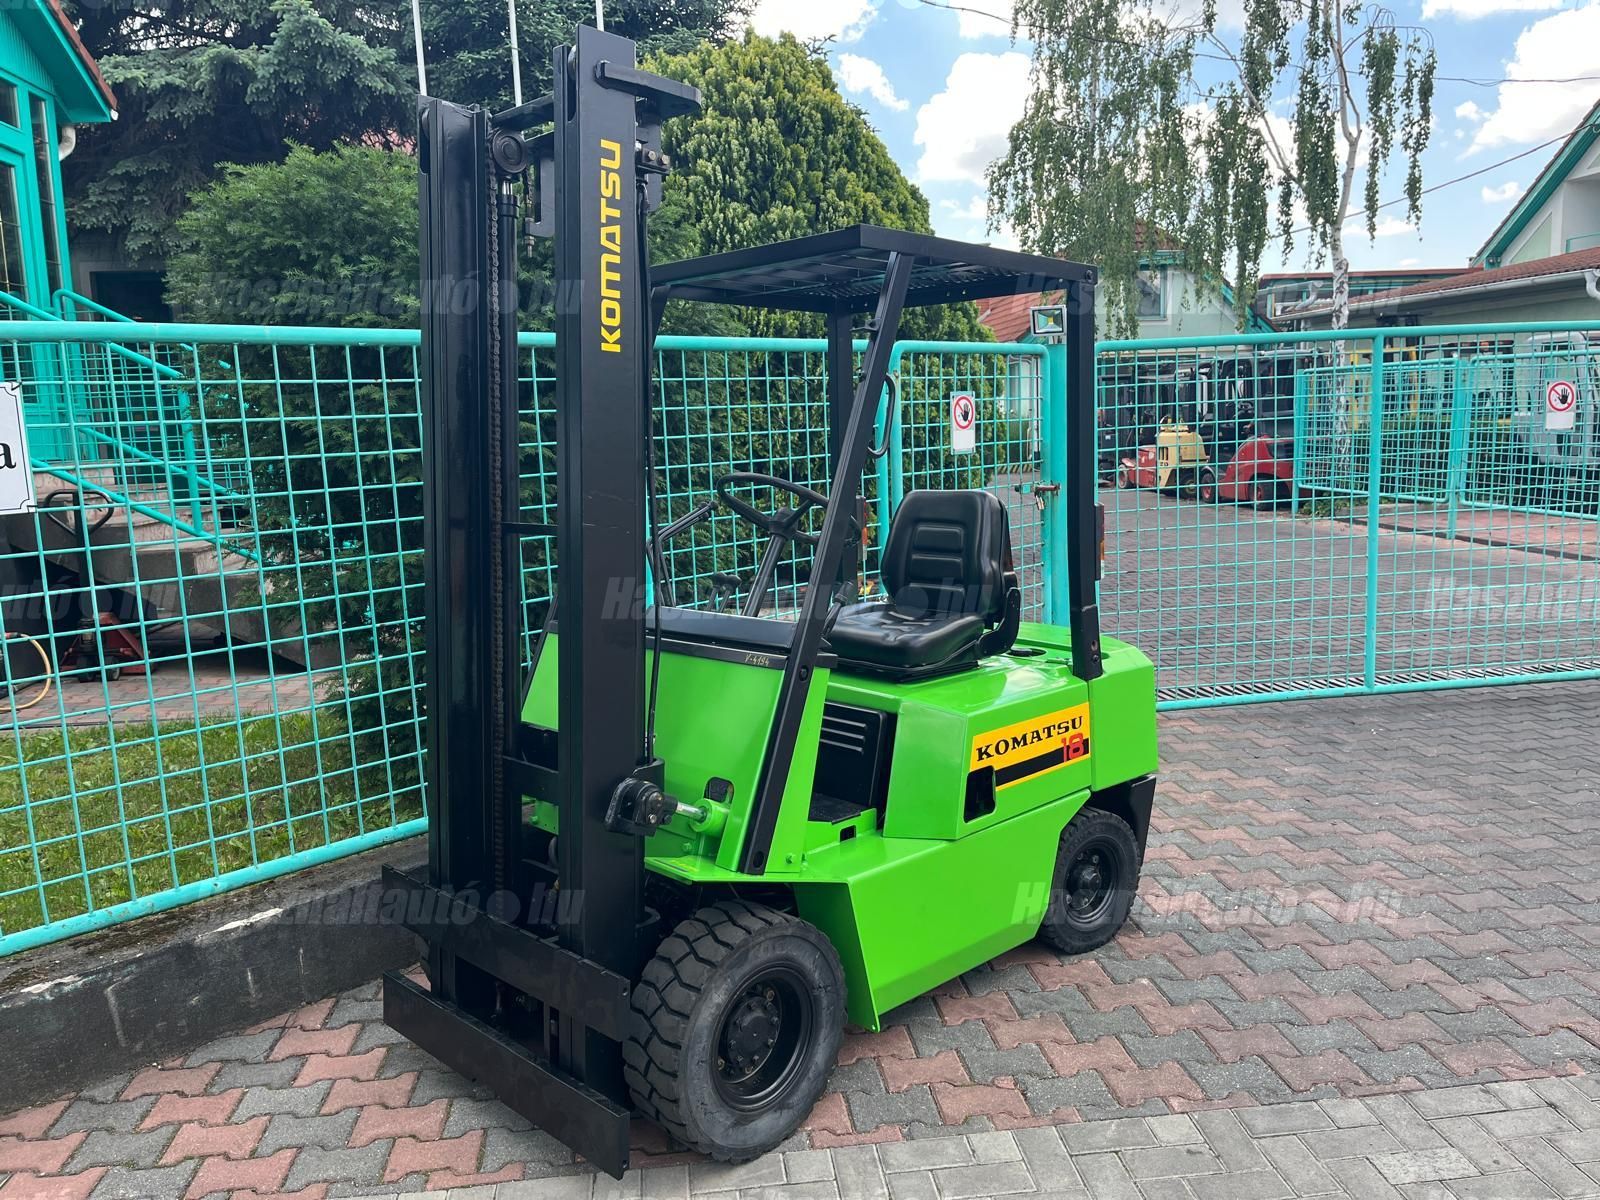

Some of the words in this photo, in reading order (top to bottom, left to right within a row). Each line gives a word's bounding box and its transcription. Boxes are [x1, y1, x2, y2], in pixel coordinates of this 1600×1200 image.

[600, 138, 621, 353] KOMATSU
[976, 716, 1083, 761] KOMATSU
[1061, 733, 1084, 762] 18
